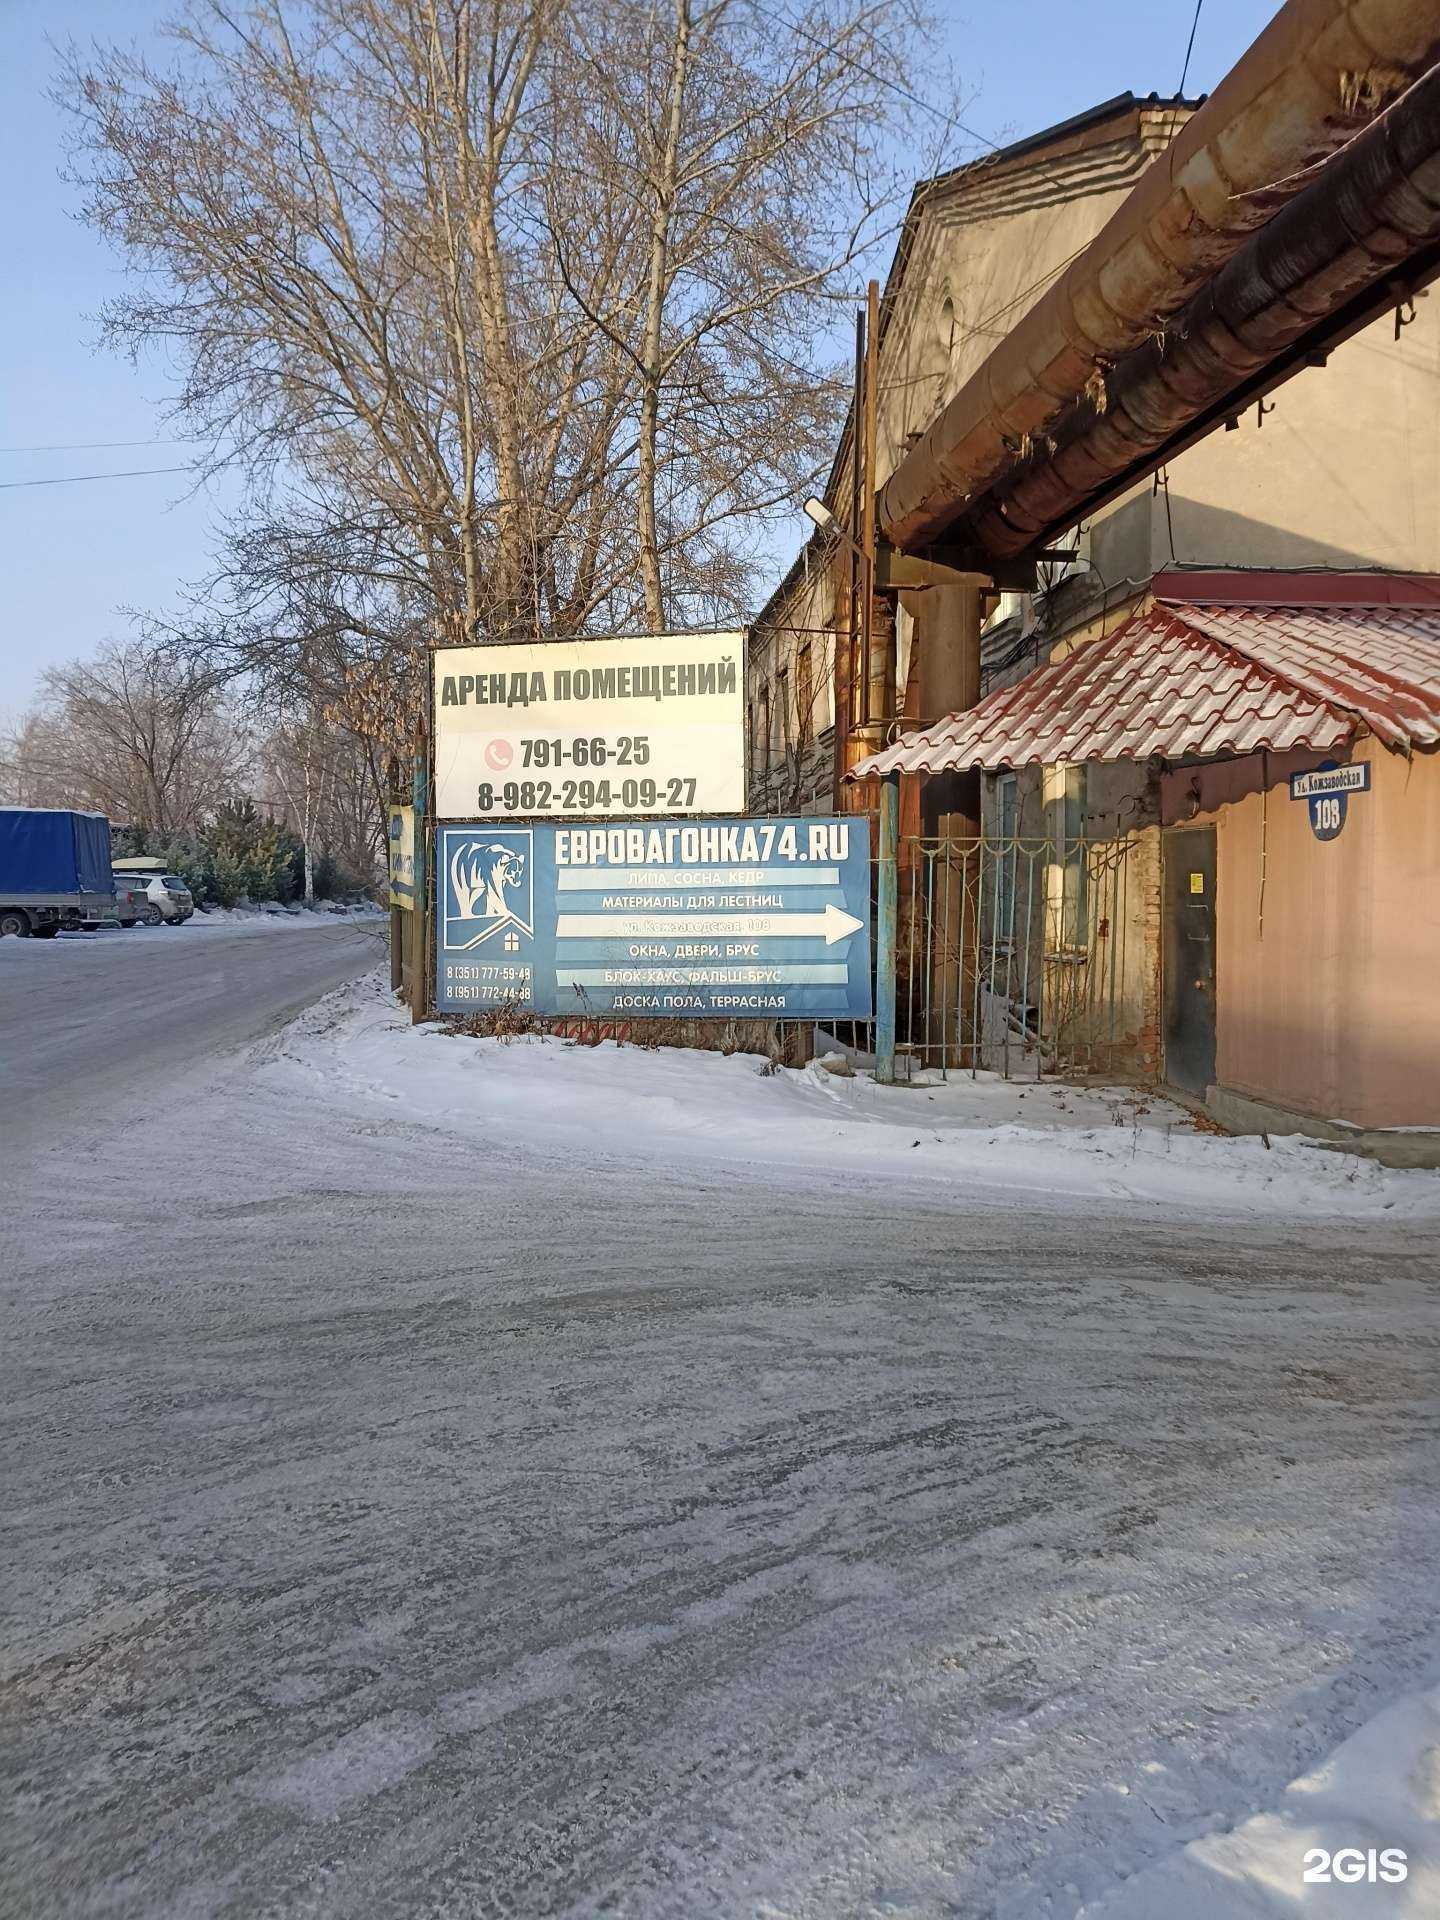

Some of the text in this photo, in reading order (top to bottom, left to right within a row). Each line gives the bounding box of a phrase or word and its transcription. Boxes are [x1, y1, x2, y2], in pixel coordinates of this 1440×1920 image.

[441, 655, 737, 708] АРЕНДА ПОМЕЩЕНИЙ
[520, 736, 650, 768] 791-66-25
[478, 778, 697, 810] 8-982-294-09-27
[1314, 798, 1341, 830] 108
[555, 823, 849, 865] ЕВРОВАГОНКА74.RU
[627, 871, 764, 886] ЛИПА, СОСНА, КЕДР
[602, 895, 784, 910] МАТЕРИАЛЫ ДЛЯ ЛЕСТНИЦ
[630, 944, 760, 958] ОКНА, ДВЕРИ, БРУС
[447, 966, 453, 978] 8
[605, 970, 782, 984] БЛОК-ХАУС, ФАЛЬШ-БРУС
[447, 986, 453, 998] 8
[613, 996, 786, 1009] ДОСКА ПОЛА, ТЕРРАСНАЯ
